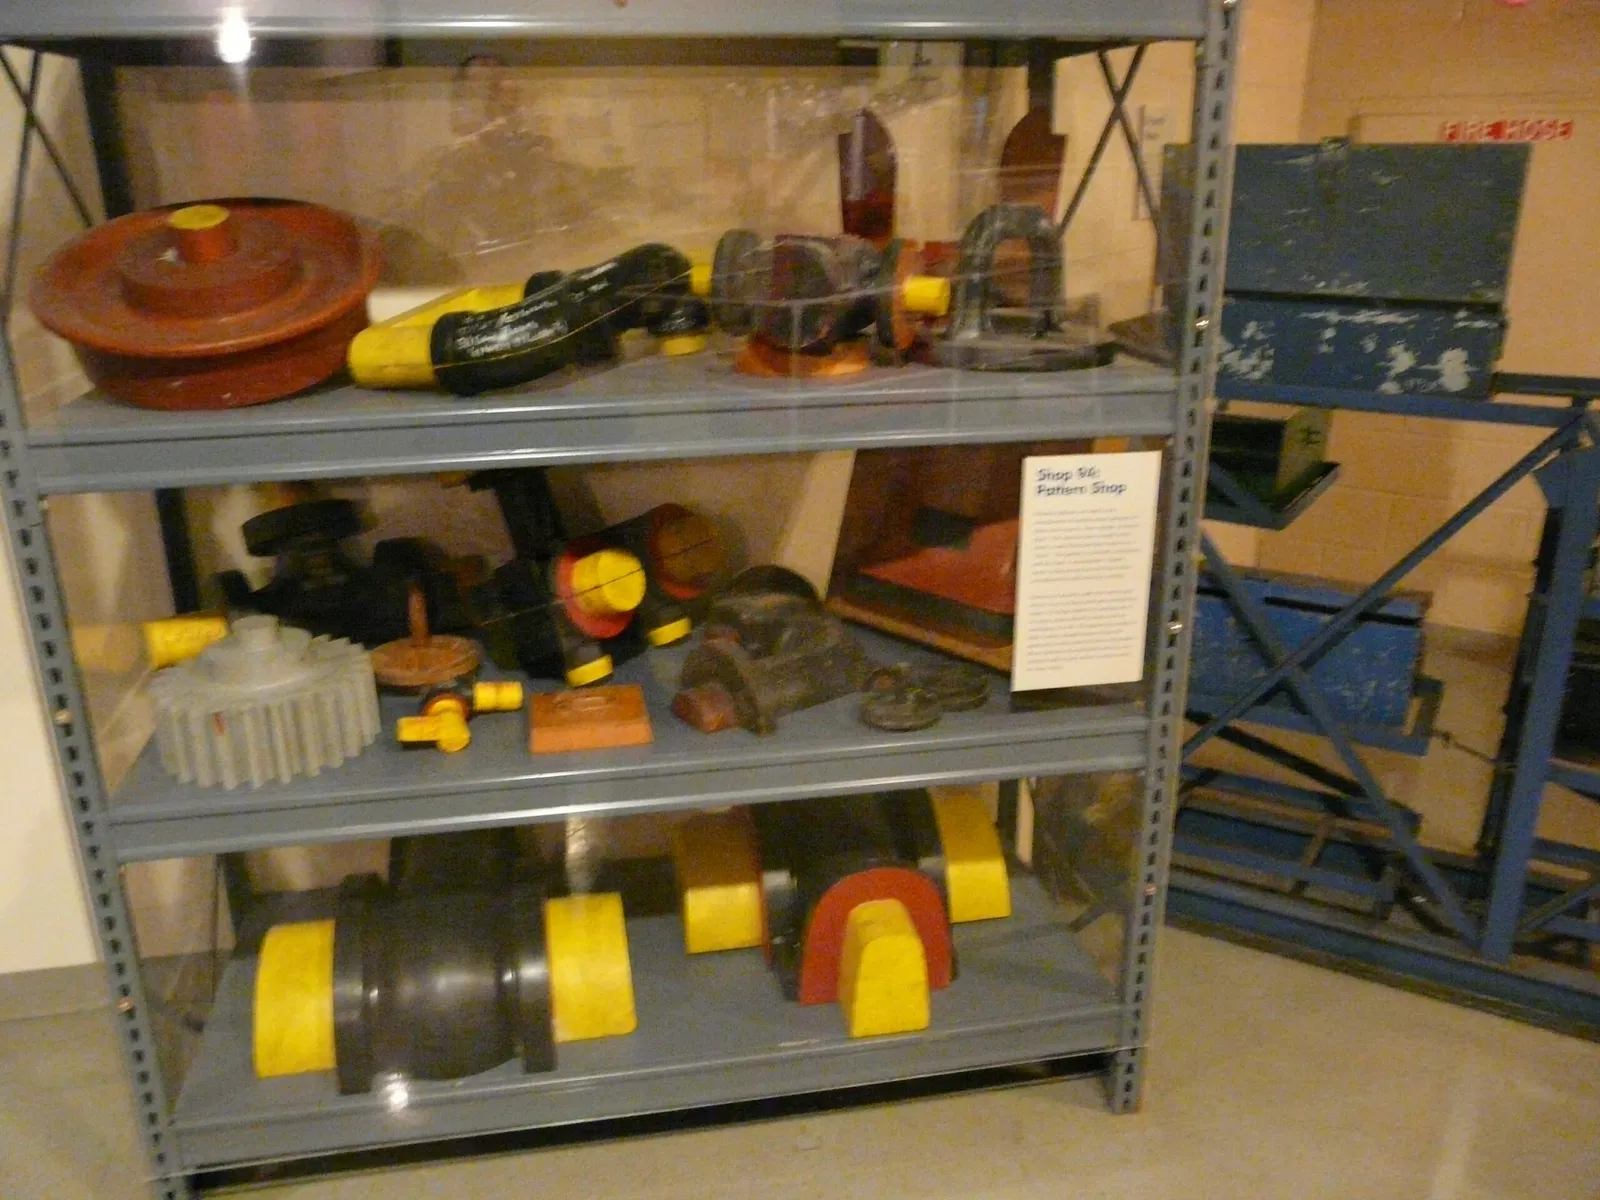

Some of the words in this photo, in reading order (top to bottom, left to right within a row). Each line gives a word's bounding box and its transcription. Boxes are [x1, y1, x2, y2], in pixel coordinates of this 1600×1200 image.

[1504, 118, 1573, 141] HOSE
[1036, 468, 1073, 482] Shop
[1036, 483, 1087, 496] Pattern
[1091, 481, 1128, 496] Shop
